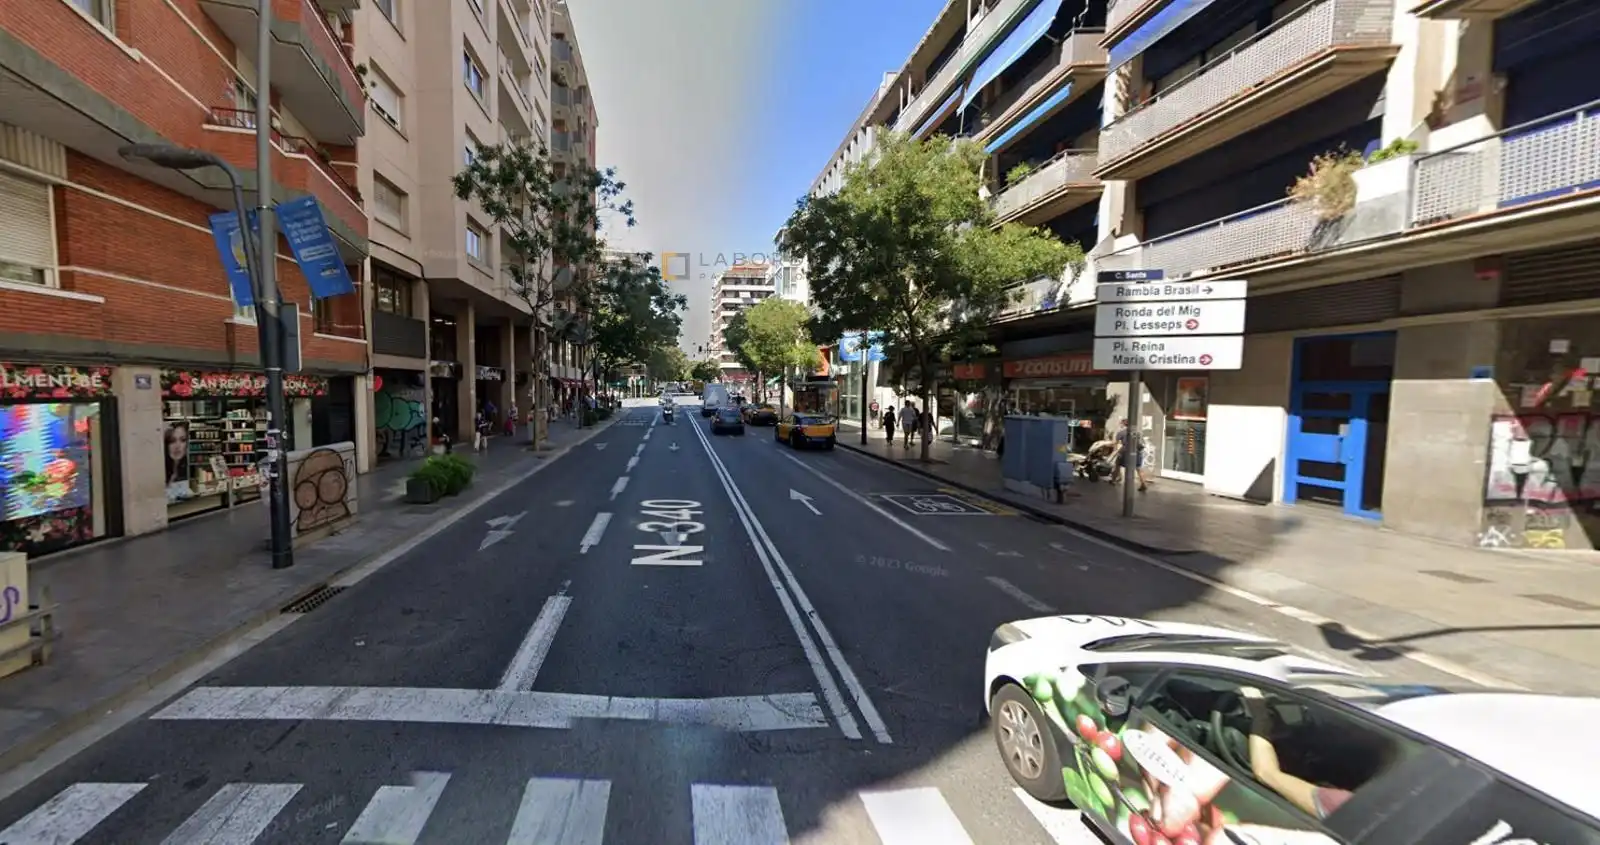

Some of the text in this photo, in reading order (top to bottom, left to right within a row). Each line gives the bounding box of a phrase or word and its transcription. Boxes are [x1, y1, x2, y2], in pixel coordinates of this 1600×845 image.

[1125, 271, 1147, 279] Sants
[1116, 285, 1200, 297] Rambla Brasil
[1115, 305, 1201, 318] Ronda del Mig
[1114, 320, 1182, 331] Pl. Lesseps
[1113, 341, 1165, 351] Pl. Reina
[1149, 354, 1196, 364] Cristina
[190, 377, 308, 389] SAN REMO BALONA
[630, 499, 706, 566] N-340
